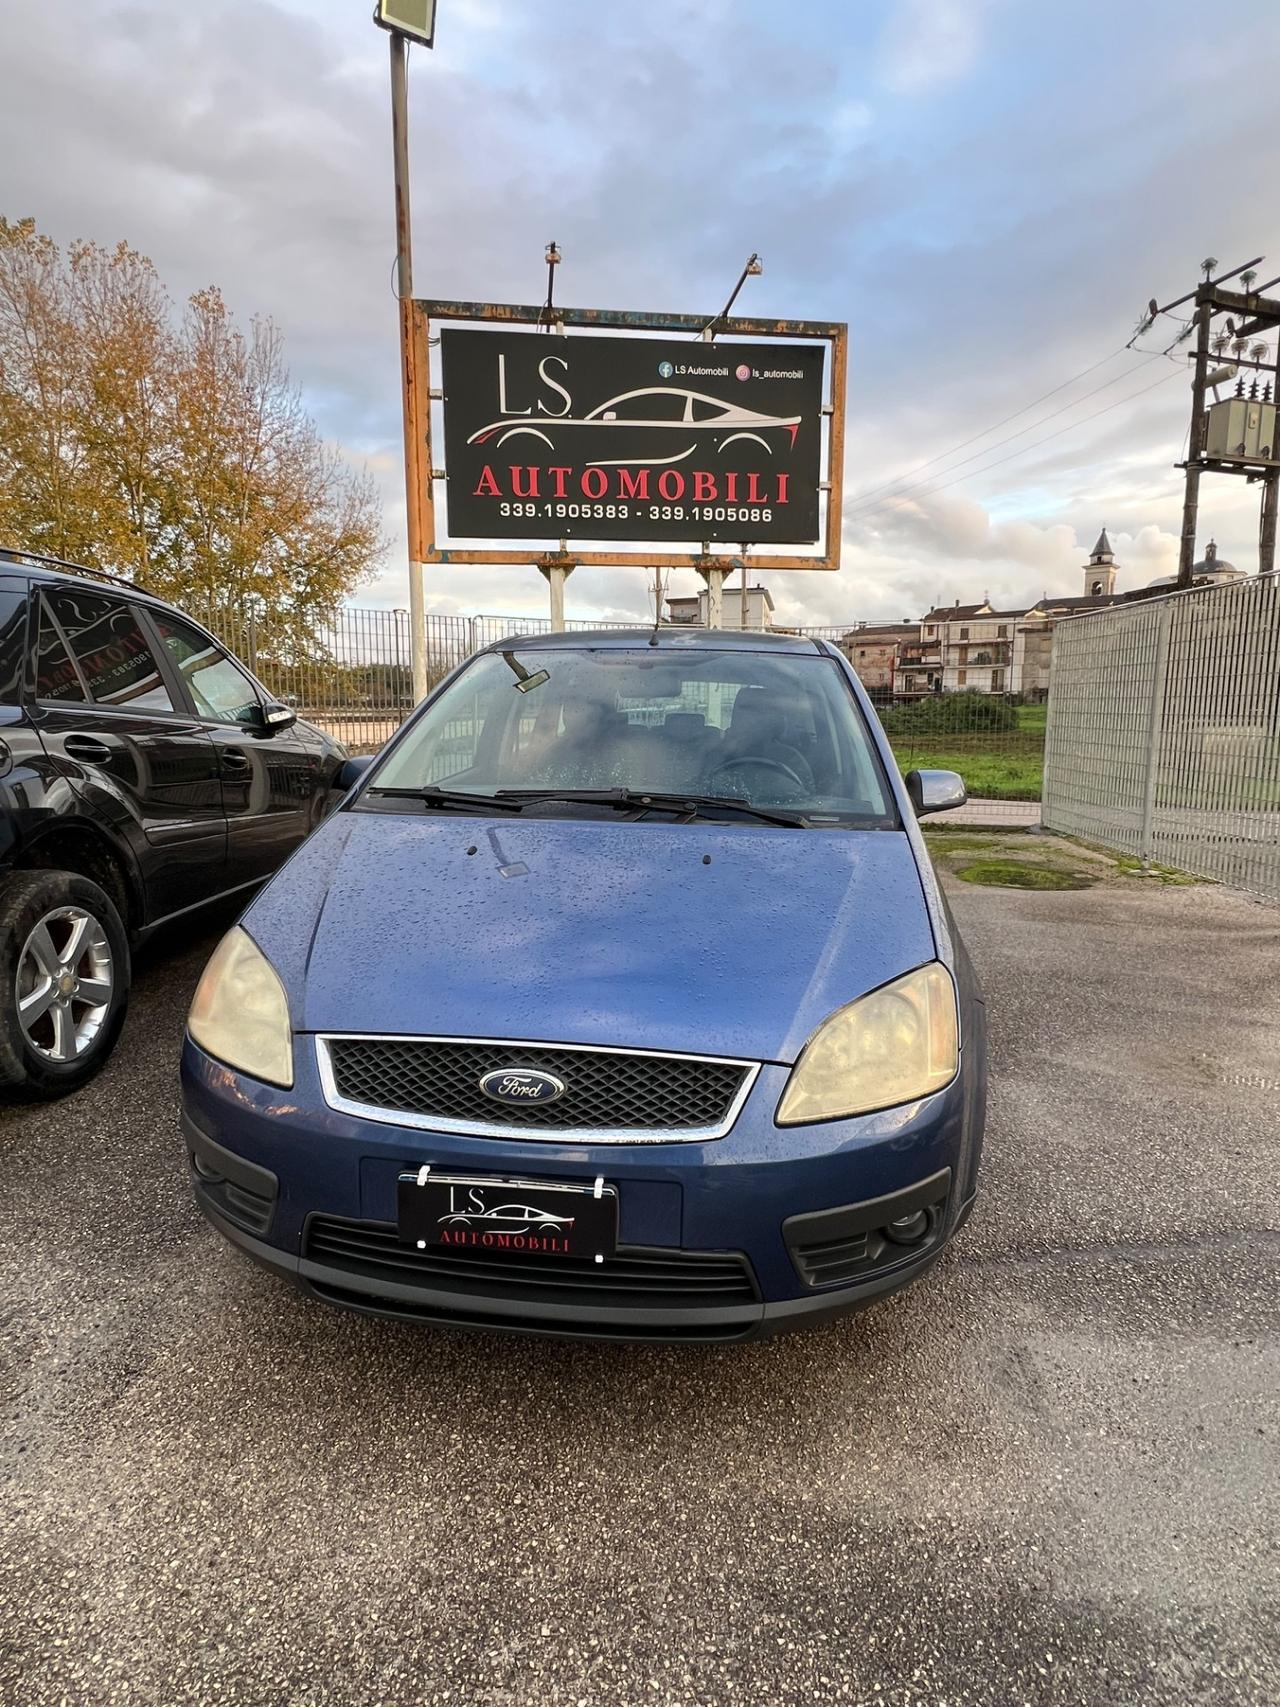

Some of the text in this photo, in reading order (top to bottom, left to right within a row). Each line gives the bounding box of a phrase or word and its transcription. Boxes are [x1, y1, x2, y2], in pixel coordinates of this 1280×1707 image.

[674, 365, 729, 376] LS Automobili
[752, 368, 804, 380] ls_automobili
[472, 464, 790, 504] AUTOMOBILI
[500, 502, 629, 519] 339.1905383
[649, 505, 773, 523] 339.1905086
[498, 1075, 543, 1098] Ford
[450, 1186, 485, 1215] LS
[440, 1229, 570, 1252] AUTOMOBILI
